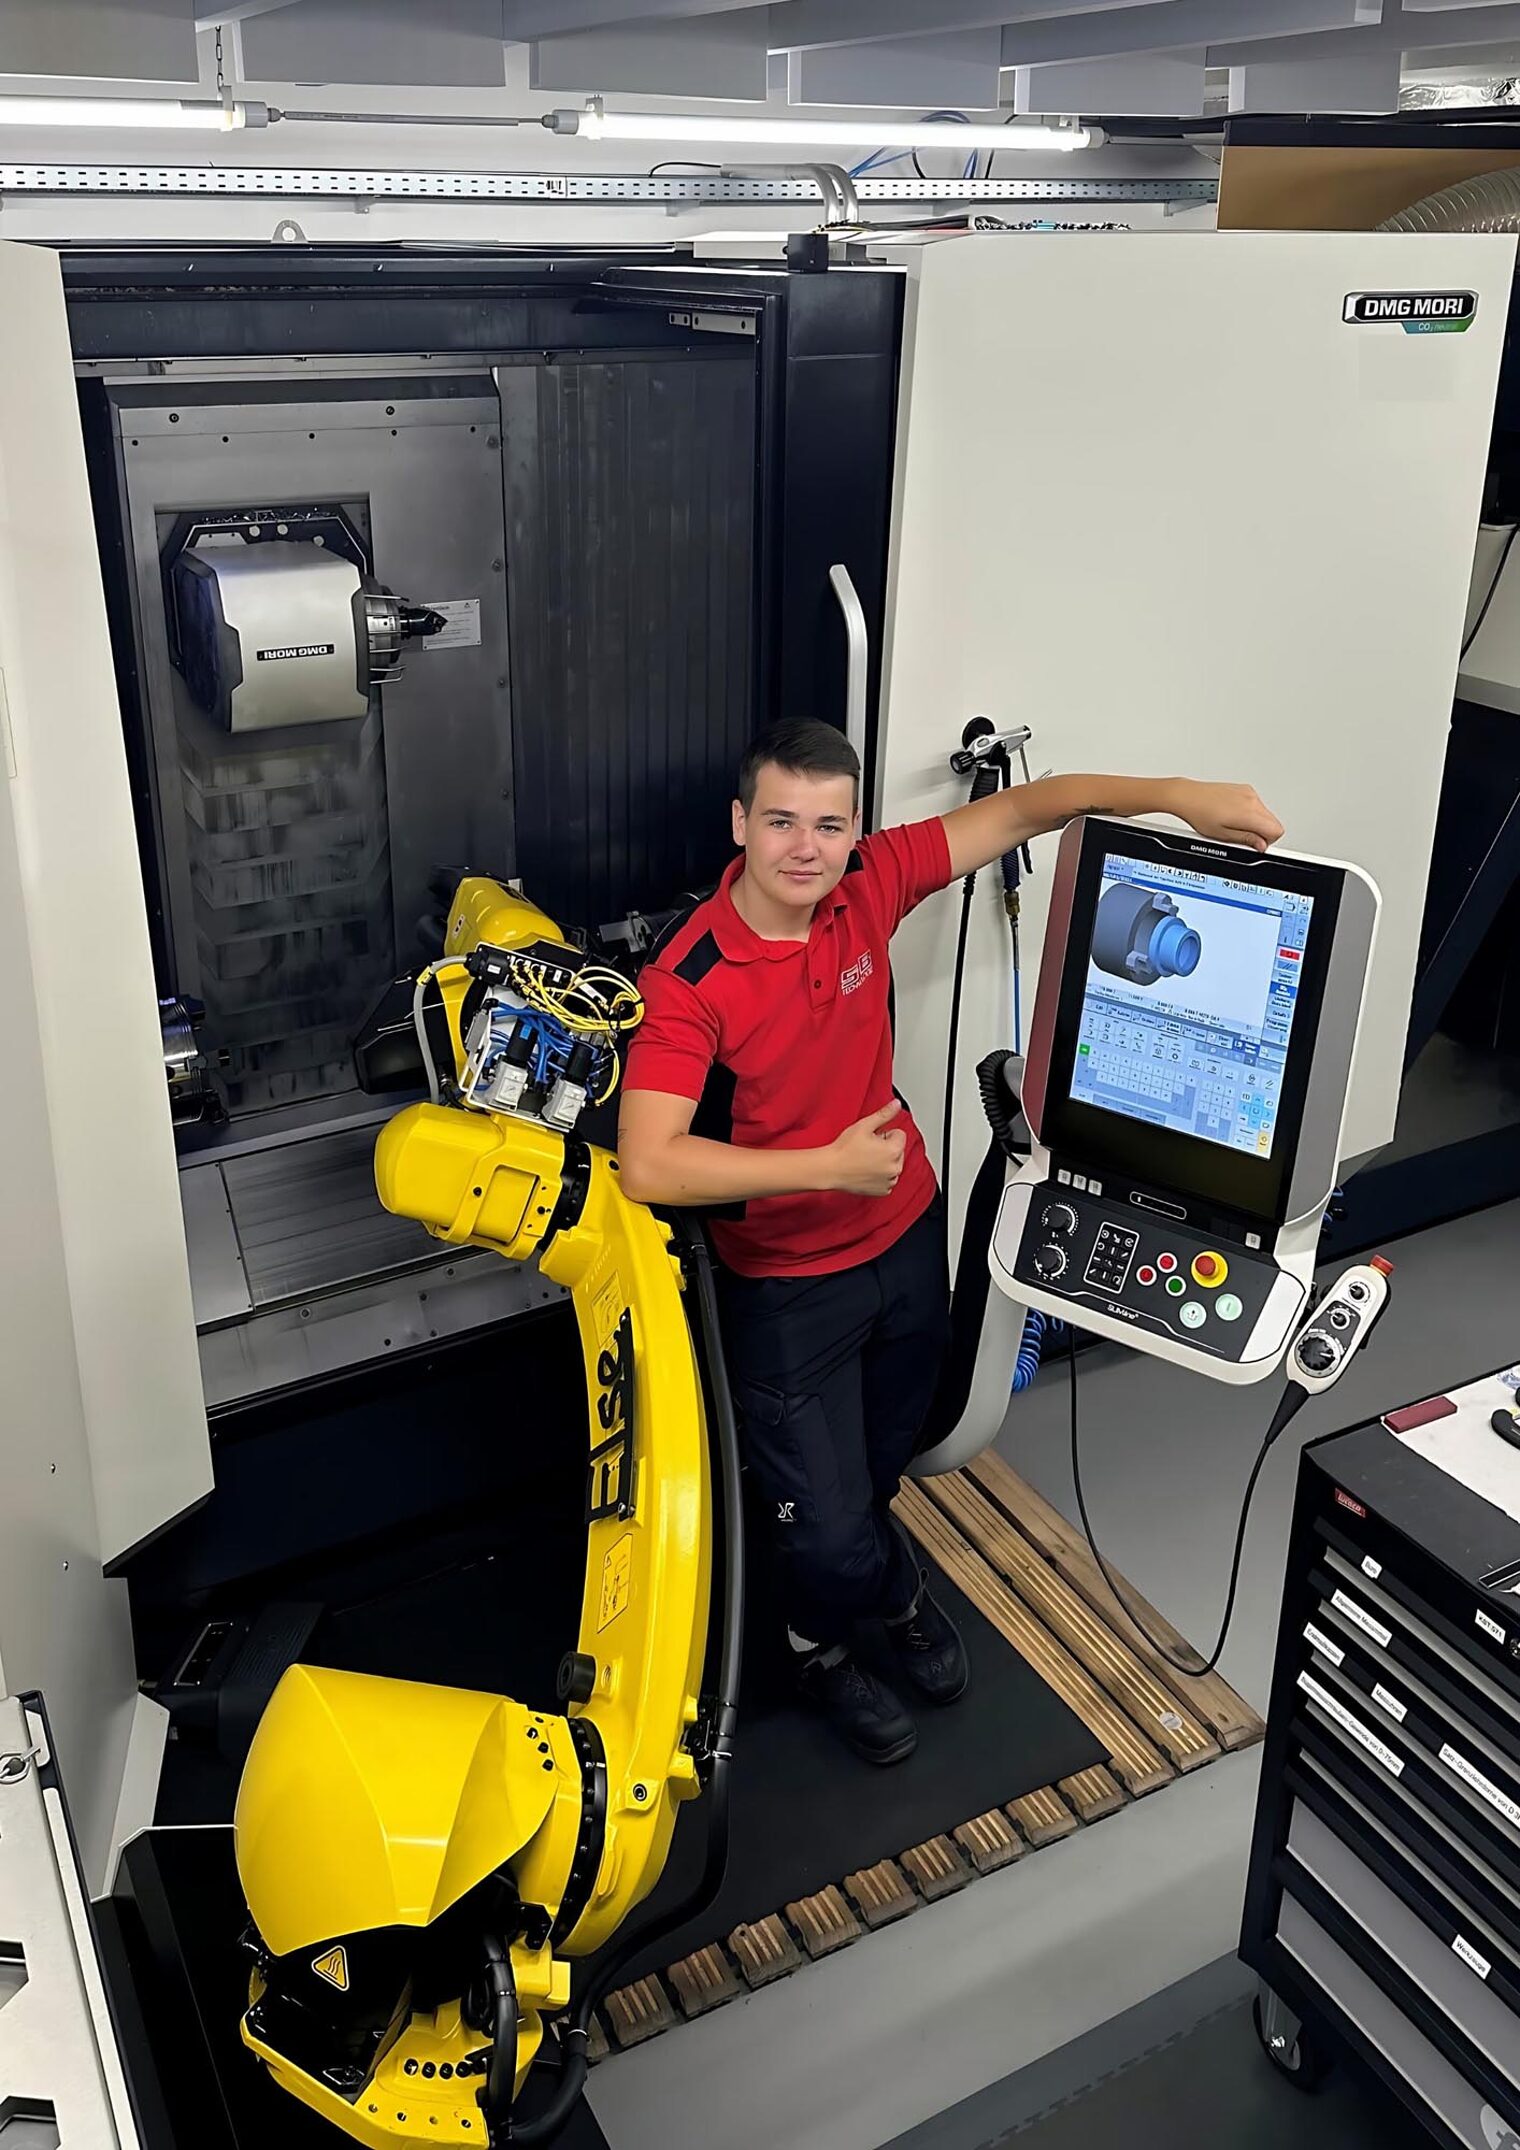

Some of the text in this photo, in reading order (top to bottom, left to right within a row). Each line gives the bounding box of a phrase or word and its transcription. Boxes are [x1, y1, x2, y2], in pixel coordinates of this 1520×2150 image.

[1364, 298, 1464, 316] DMG MORI
[263, 645, 328, 660] DMG MORI
